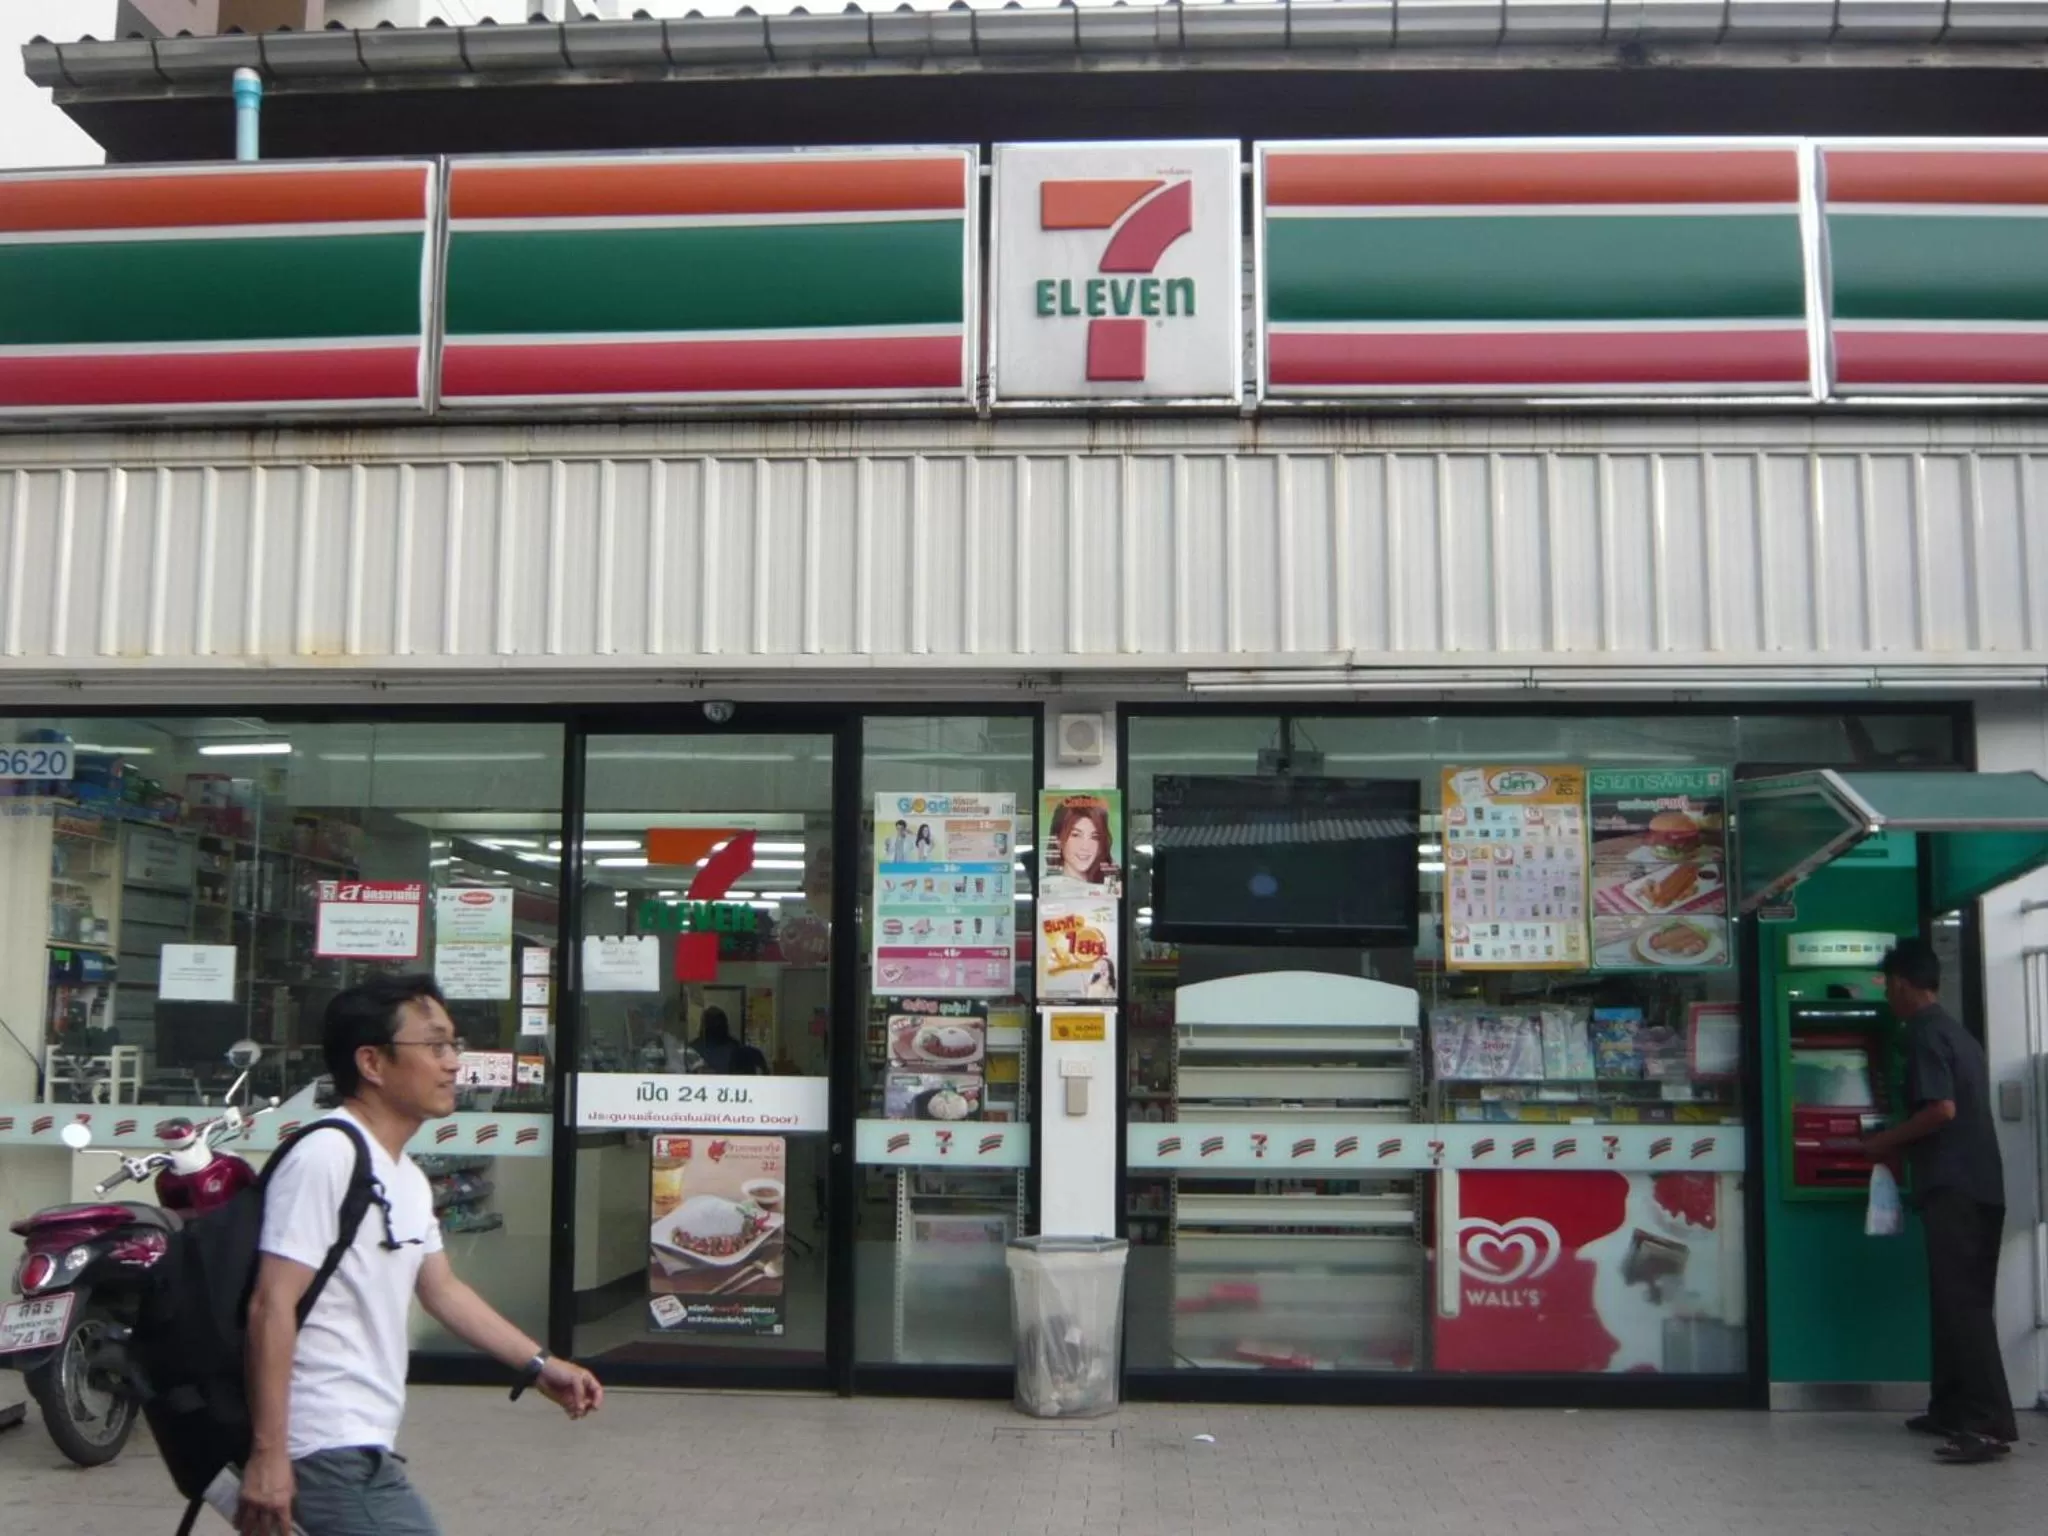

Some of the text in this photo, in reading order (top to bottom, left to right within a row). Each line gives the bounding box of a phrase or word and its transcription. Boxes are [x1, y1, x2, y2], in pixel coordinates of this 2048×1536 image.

[636, 1081, 669, 1102] เปิด
[678, 1086, 708, 1102] 24
[1466, 1288, 1541, 1308] WALL'S
